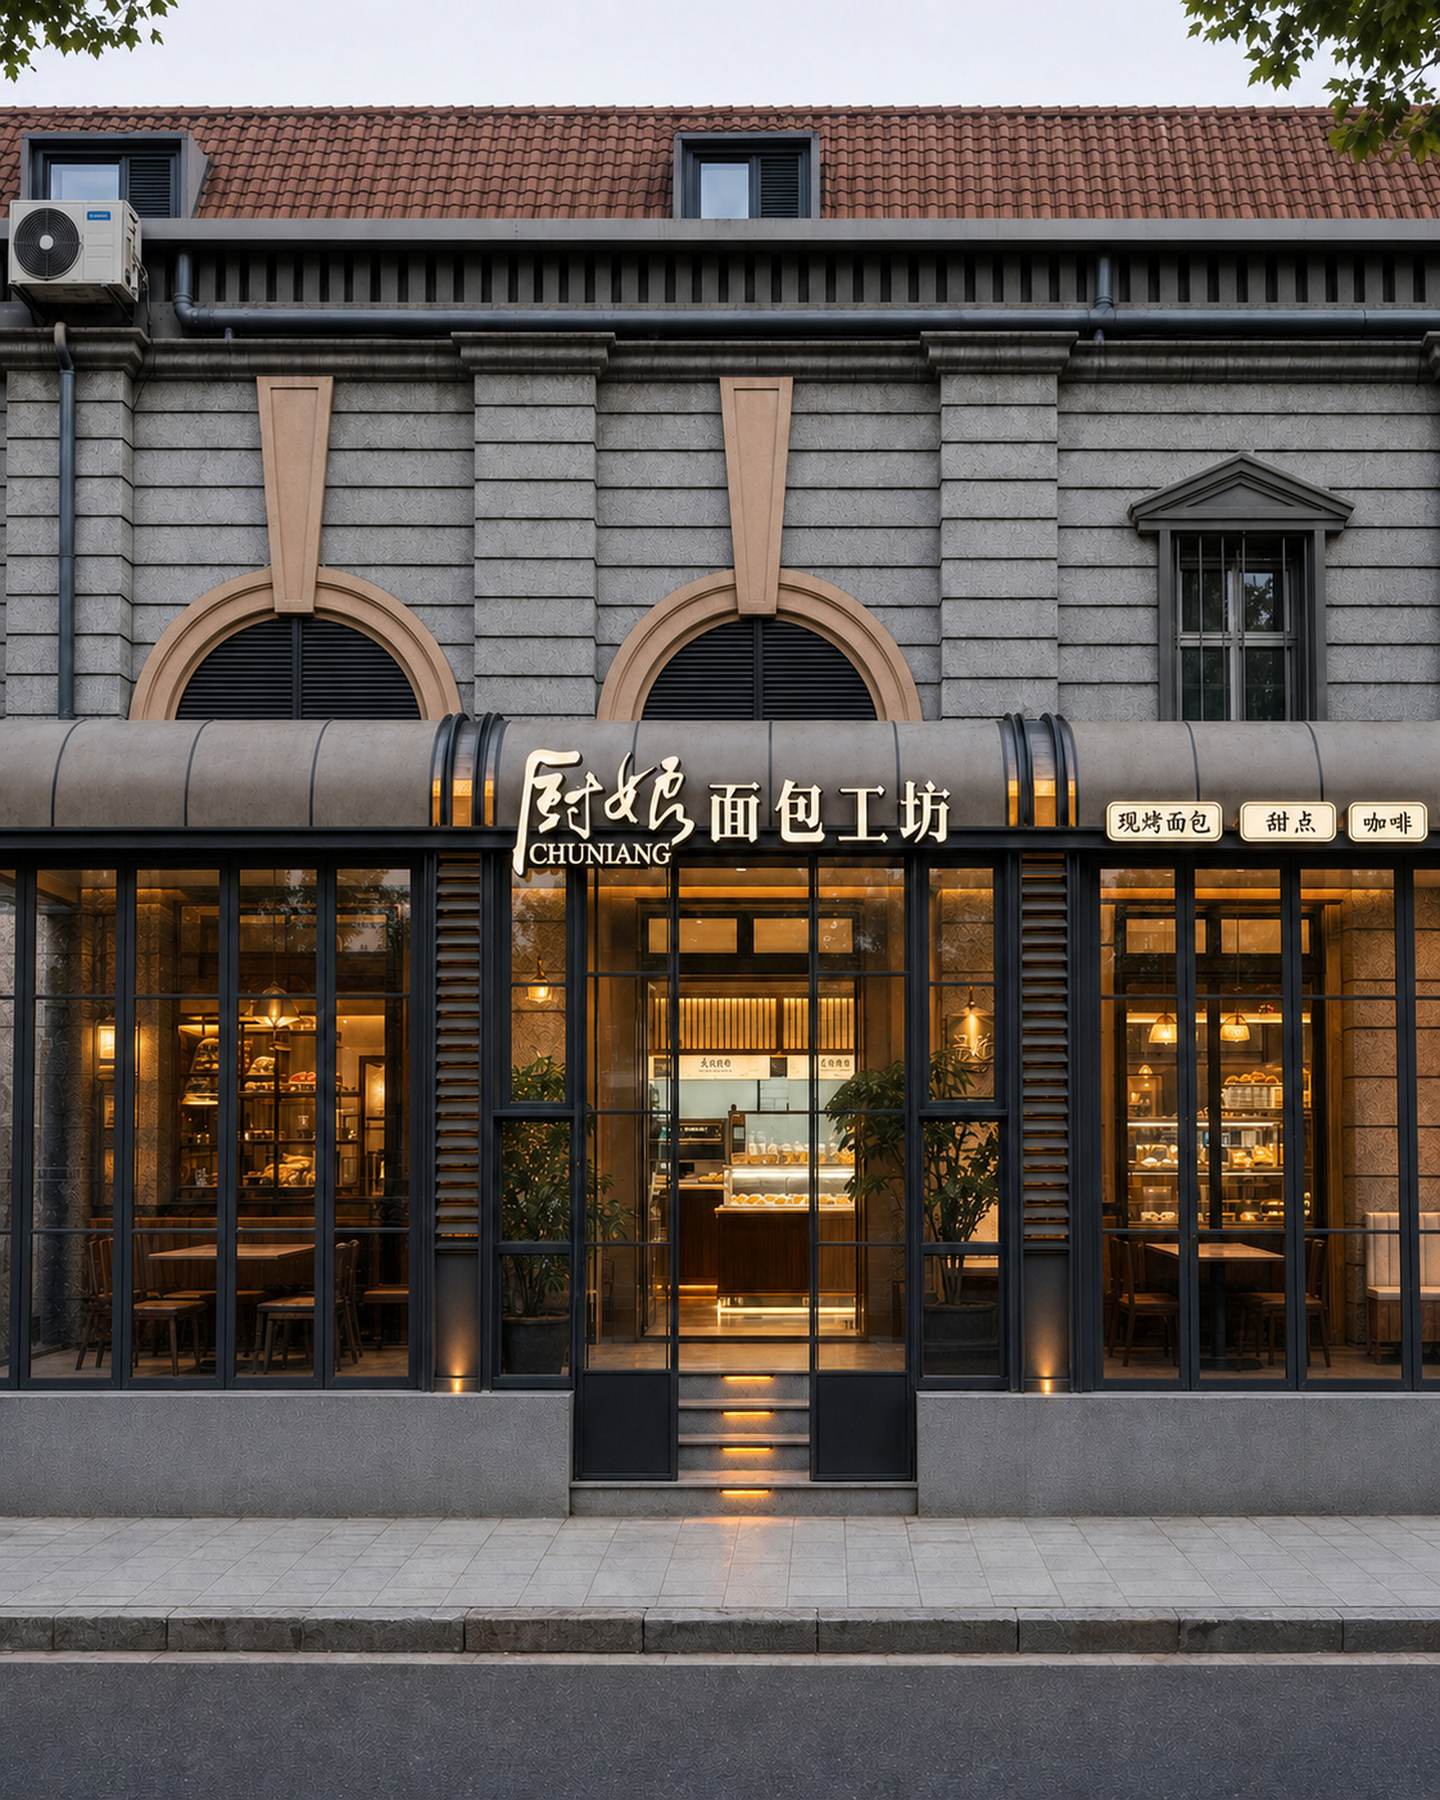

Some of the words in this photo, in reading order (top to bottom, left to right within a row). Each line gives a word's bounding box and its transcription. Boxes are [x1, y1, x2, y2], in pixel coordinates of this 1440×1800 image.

[709, 779, 950, 843] 面包工坊
[1118, 810, 1211, 834] 现烤面包
[1266, 810, 1317, 834] 甜点
[1363, 811, 1413, 835] 咖啡
[529, 842, 672, 865] CHUNIANG
